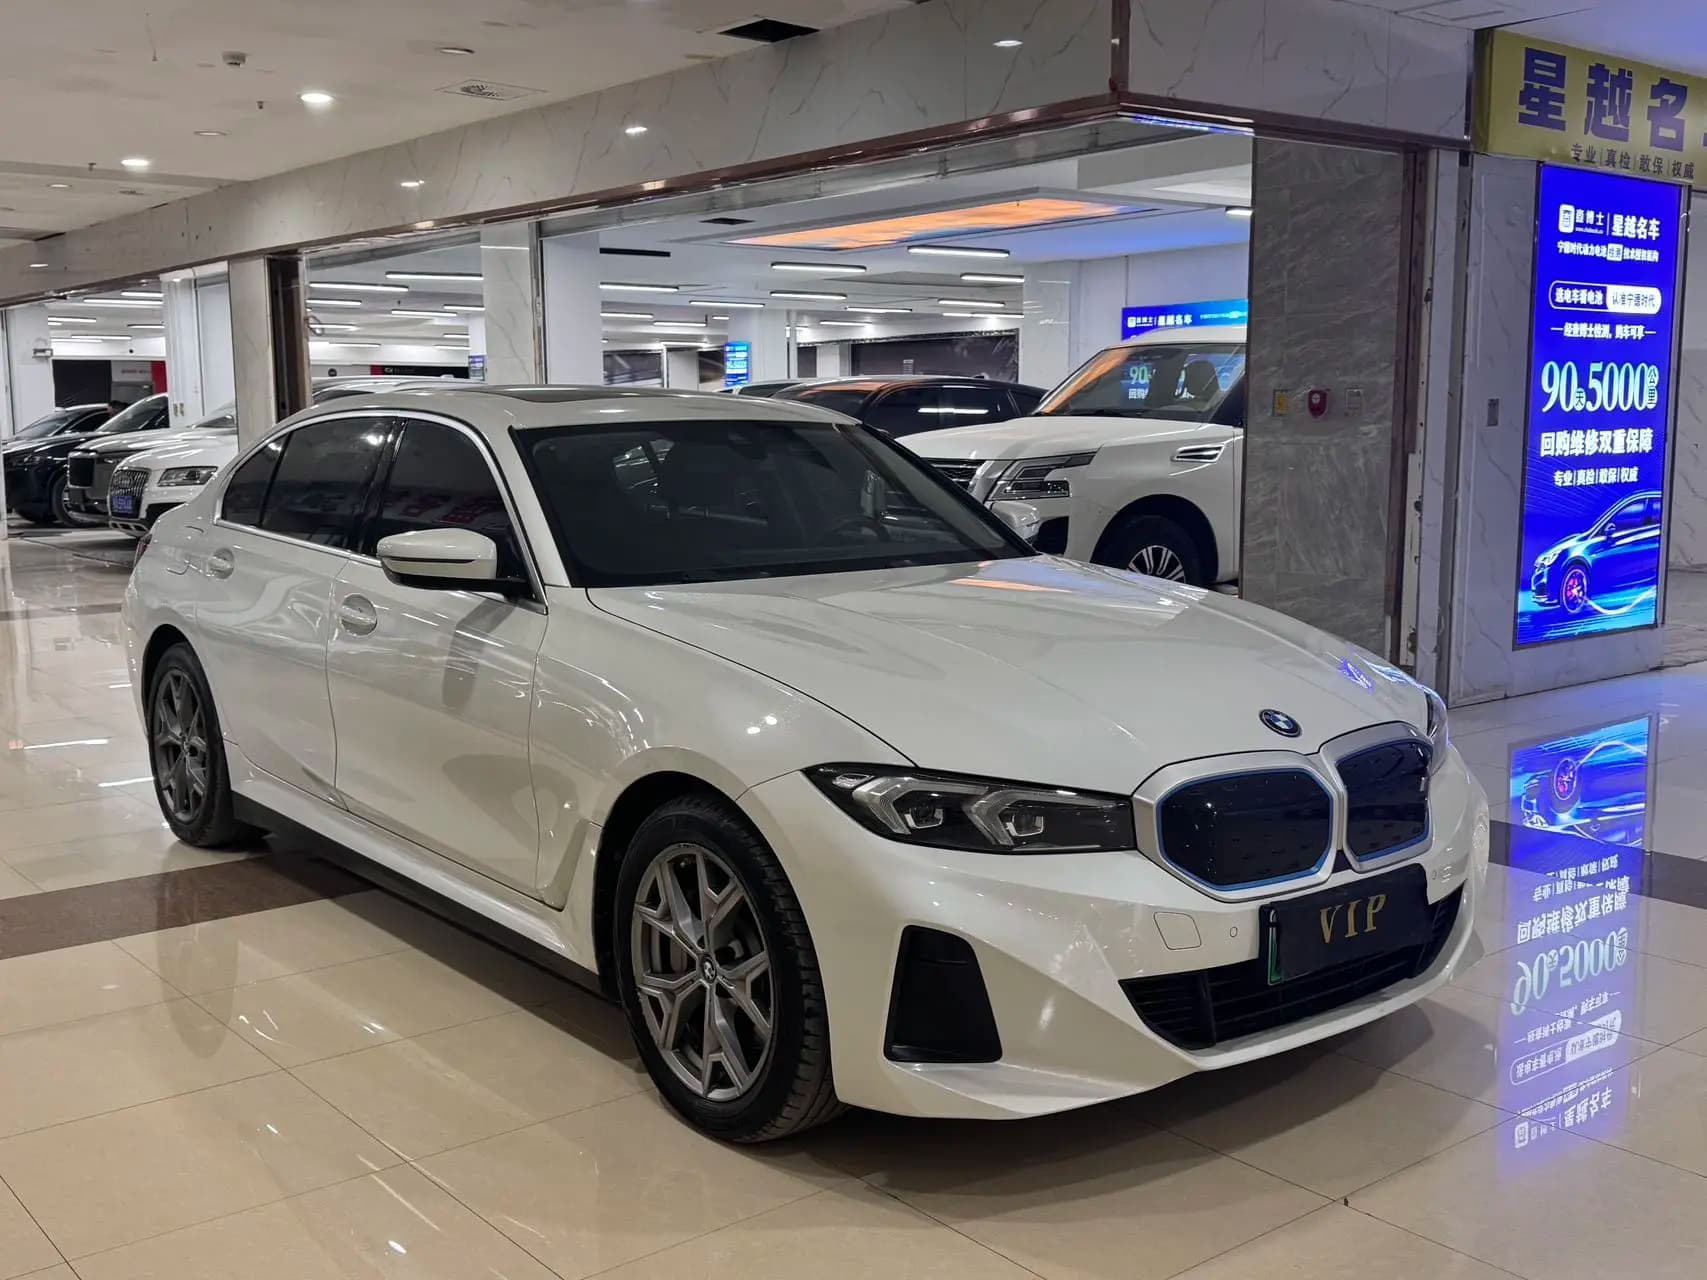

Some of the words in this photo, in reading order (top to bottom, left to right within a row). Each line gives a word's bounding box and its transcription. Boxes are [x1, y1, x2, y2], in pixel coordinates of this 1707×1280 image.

[1518, 47, 1707, 152] 星越名
[1611, 214, 1660, 241] 星越名车
[1540, 428, 1654, 457] 回购维修双重保障
[1319, 893, 1388, 944] VIP
